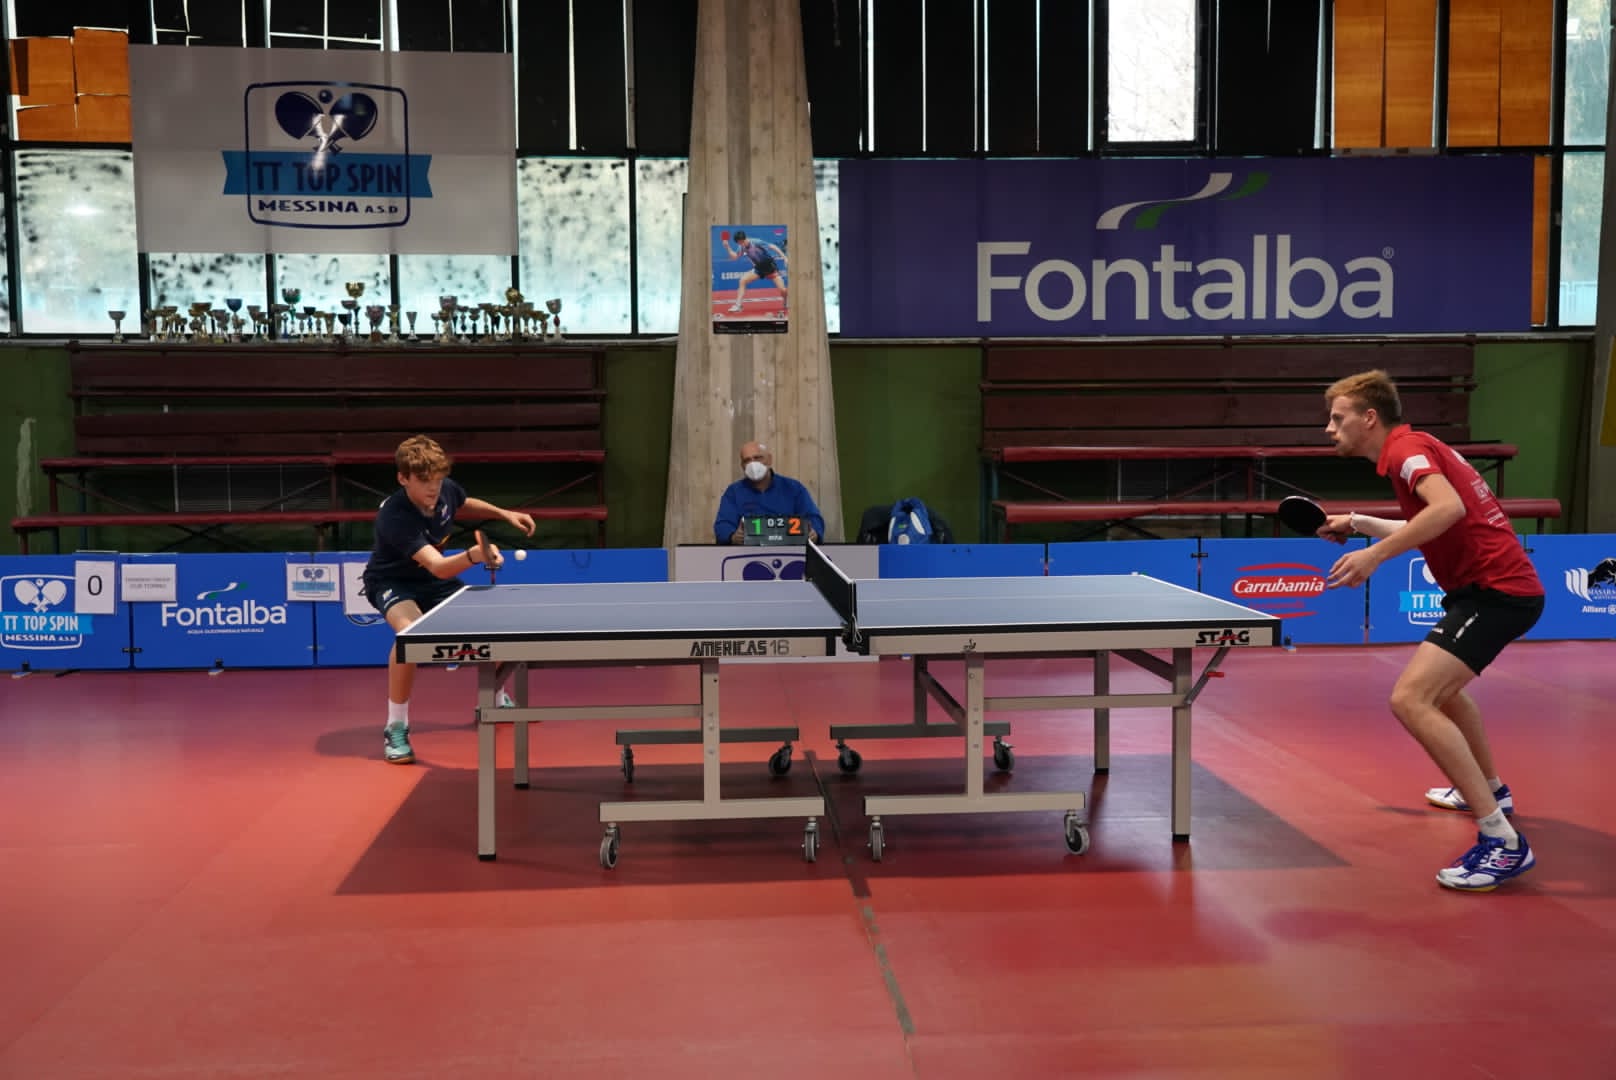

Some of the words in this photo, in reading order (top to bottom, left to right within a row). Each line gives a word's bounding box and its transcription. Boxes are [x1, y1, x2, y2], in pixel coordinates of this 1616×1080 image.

[253, 161, 282, 191] TT
[292, 162, 341, 192] TOP
[347, 162, 402, 193] SPIN
[258, 200, 359, 214] MESSINA
[751, 518, 761, 536] 1
[788, 517, 801, 535] 2
[87, 575, 103, 596] 0
[1233, 577, 1326, 593] Carrubamia
[1412, 594, 1425, 608] TT
[1429, 594, 1442, 608] TO
[1582, 605, 1607, 613] Allianz
[2, 615, 18, 631] TT
[23, 615, 47, 631] TOP
[49, 615, 79, 631] SPIN
[5, 633, 57, 641] MESSINA
[1195, 628, 1250, 646] STAG
[431, 643, 491, 661] STAG
[689, 640, 768, 657] AMERICAS
[769, 639, 790, 656] 16
